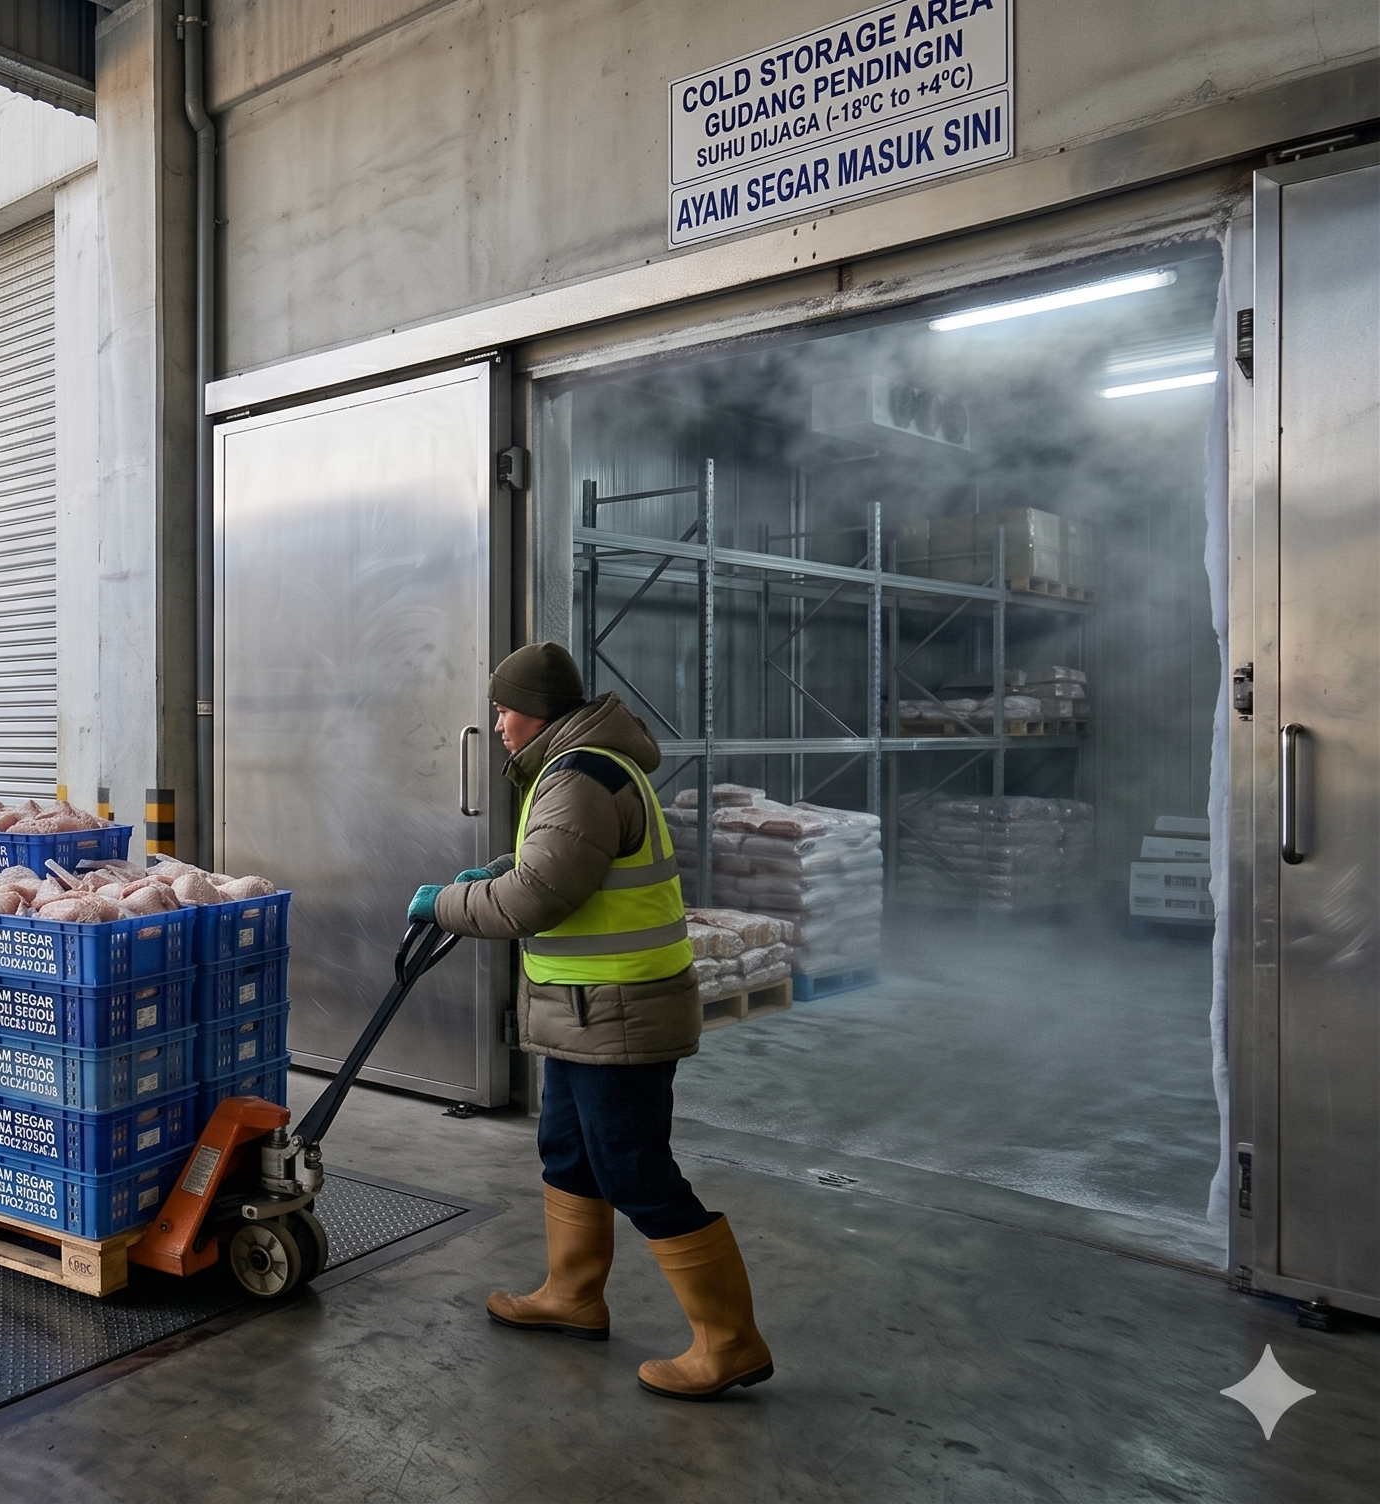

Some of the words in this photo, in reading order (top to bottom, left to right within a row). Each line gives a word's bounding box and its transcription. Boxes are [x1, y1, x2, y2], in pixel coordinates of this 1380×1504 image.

[682, 69, 751, 114] COLD
[760, 13, 896, 87] STORAGE
[705, 84, 806, 138] GUDANG
[814, 29, 963, 104] PENDINGIN
[697, 133, 745, 168] SUHU
[751, 112, 820, 152] DIJAGA
[890, 88, 910, 109] to
[676, 184, 738, 232] AYAM
[747, 158, 829, 212] SEGAR
[838, 126, 935, 185] MASUK
[944, 106, 1001, 155] SINI
[14, 931, 53, 947] SEGAR
[14, 991, 53, 1009] SEGAR
[14, 1051, 54, 1070] SEGAR
[14, 1112, 54, 1132] SEGAR
